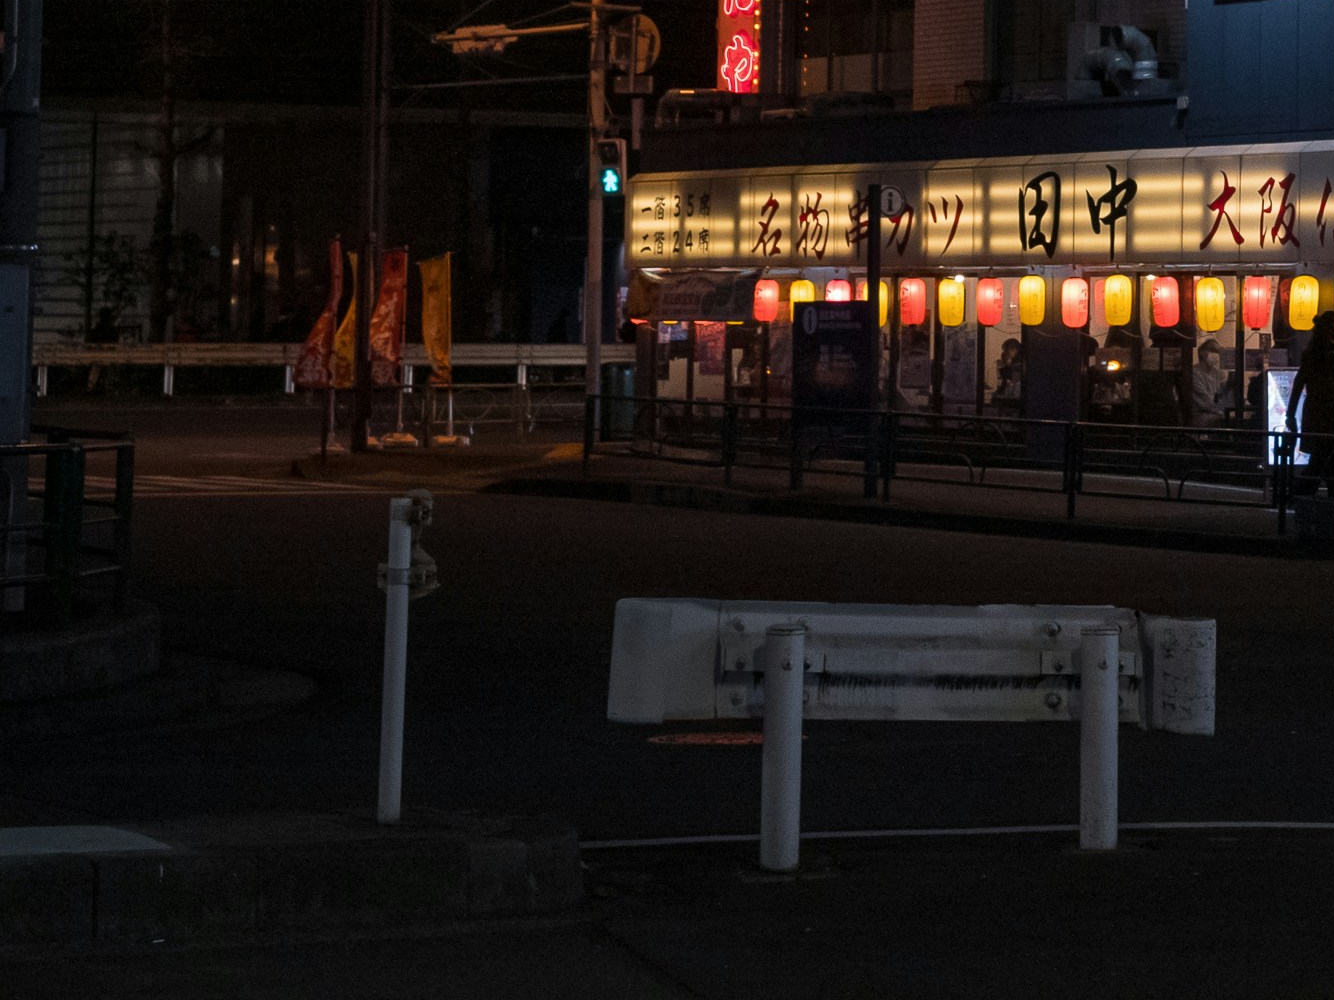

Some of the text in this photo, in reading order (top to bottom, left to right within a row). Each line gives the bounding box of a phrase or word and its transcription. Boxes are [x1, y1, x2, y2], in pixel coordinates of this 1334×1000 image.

[641, 193, 711, 220] 一階35席
[1018, 165, 1138, 261] 田中
[640, 227, 711, 255] 二階24席
